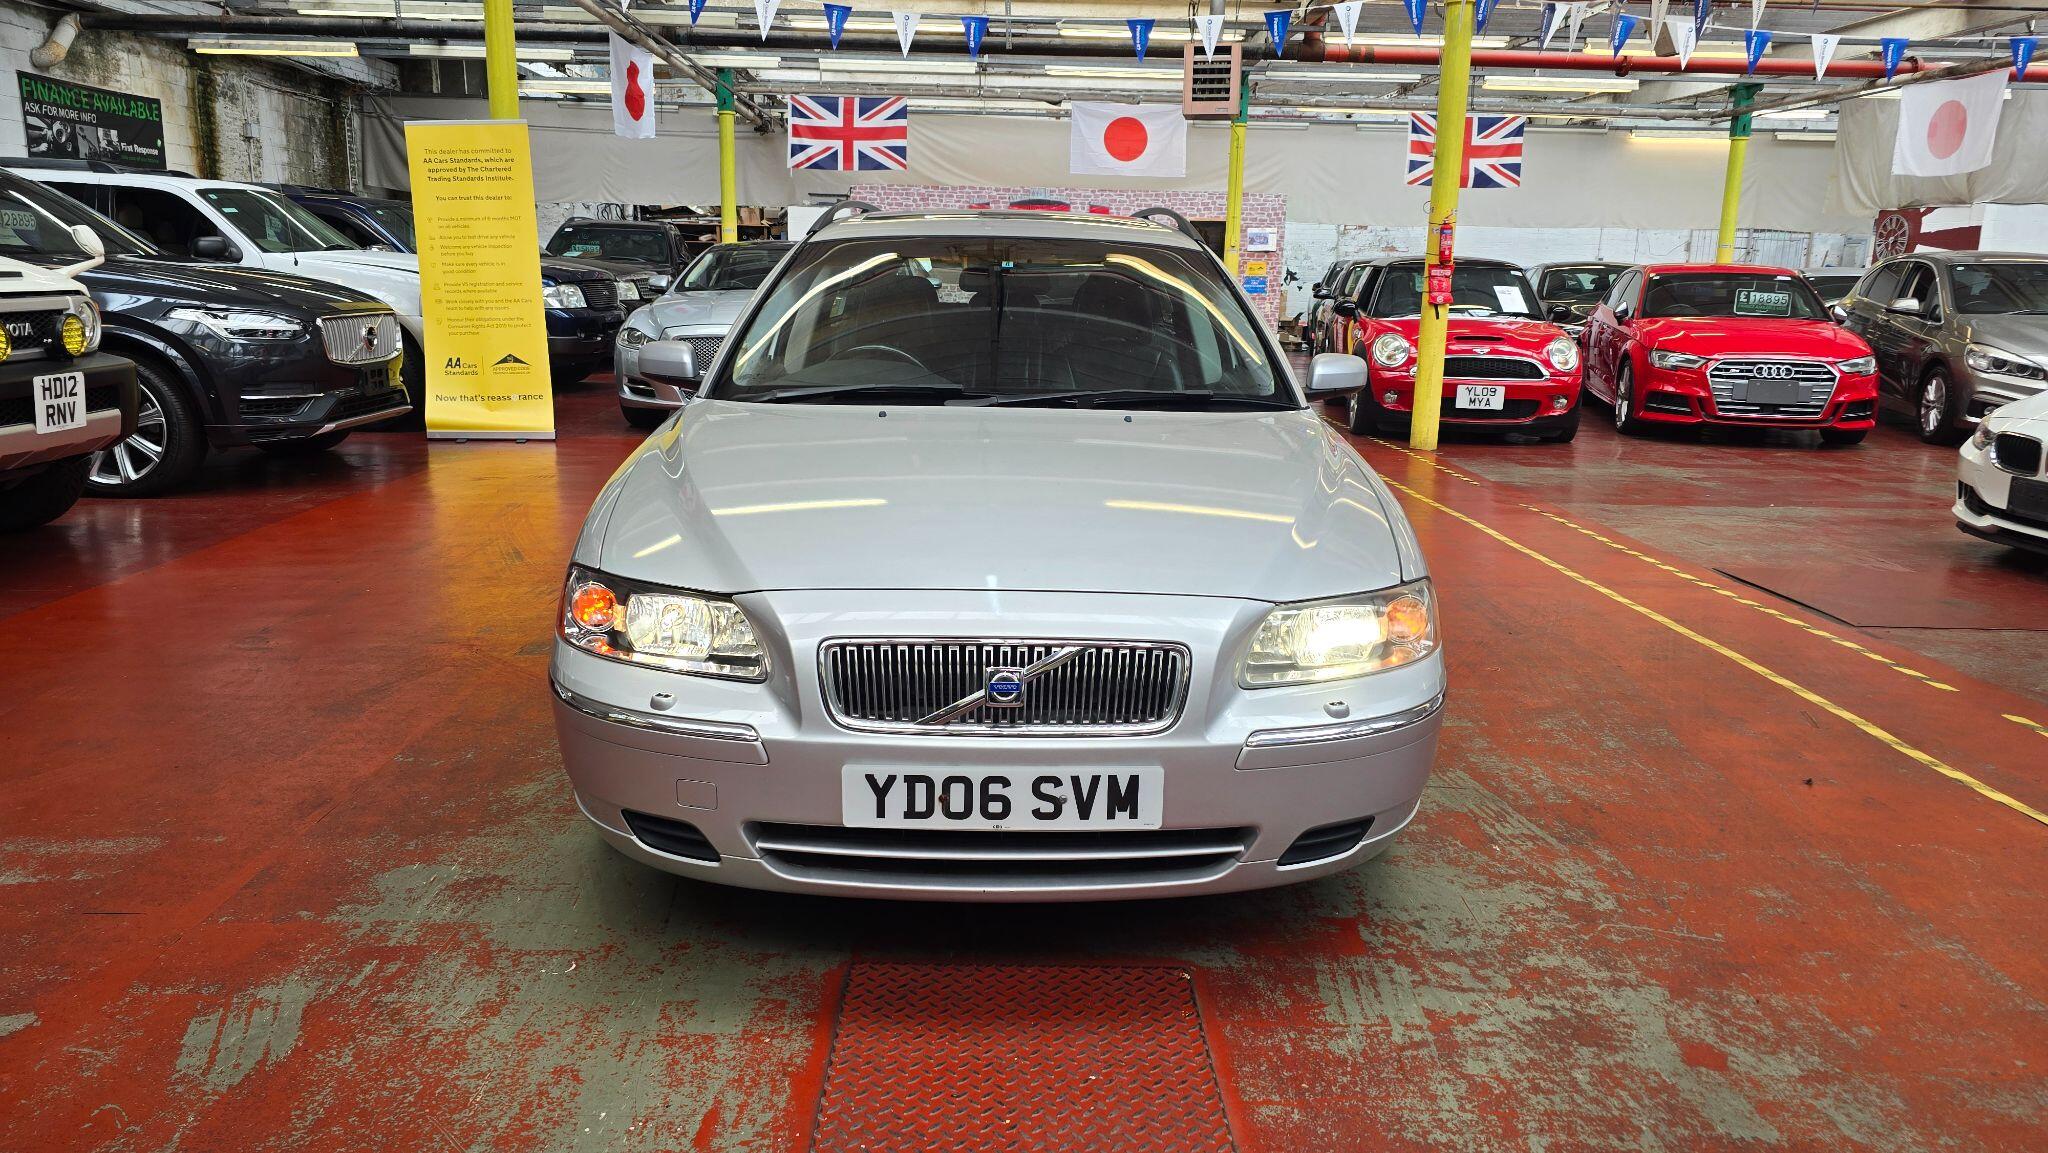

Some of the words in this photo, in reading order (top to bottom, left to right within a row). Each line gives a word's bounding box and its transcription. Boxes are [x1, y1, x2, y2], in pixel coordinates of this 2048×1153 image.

[22, 77, 90, 109] FINANCE
[93, 92, 160, 121] AVAILABLE
[24, 102, 41, 114] ASK
[42, 105, 58, 116] FOR
[58, 107, 80, 121] MORE
[80, 111, 97, 123] INFO
[120, 142, 134, 153] First
[134, 144, 159, 156] Response
[444, 357, 461, 369] AA
[41, 374, 79, 400] HD12
[1466, 386, 1497, 397] YL09
[435, 394, 458, 402] Now
[459, 393, 486, 402] that's
[1469, 397, 1491, 408] MYA
[46, 400, 77, 427] RNV
[864, 773, 1012, 821] YD06
[1031, 773, 1139, 821] SVM
